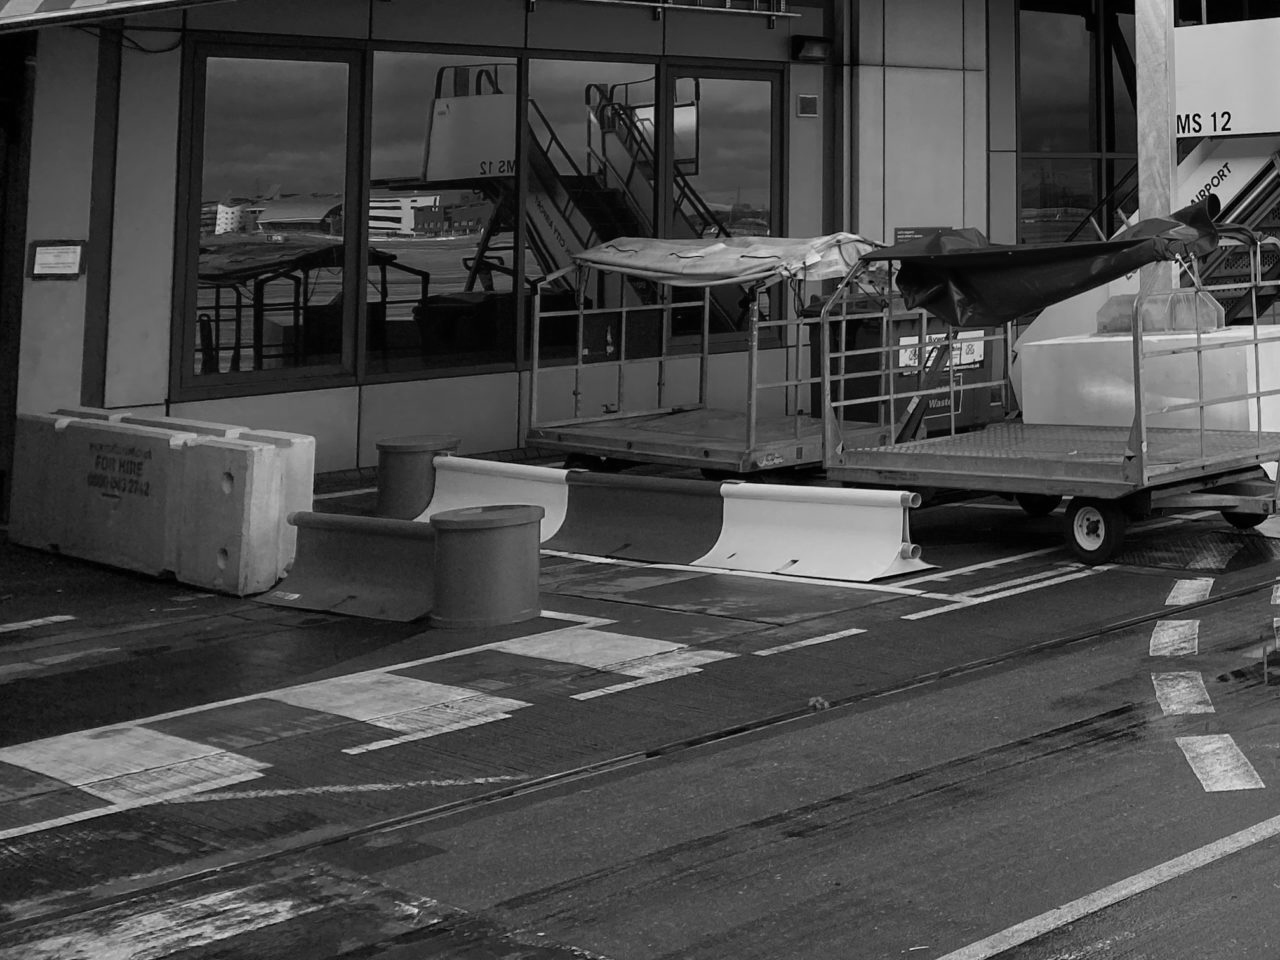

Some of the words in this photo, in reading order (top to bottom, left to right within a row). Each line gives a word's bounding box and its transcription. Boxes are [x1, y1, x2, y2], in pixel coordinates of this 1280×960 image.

[1176, 113, 1202, 134] MS
[1211, 111, 1232, 132] 12
[95, 454, 116, 472] FOR
